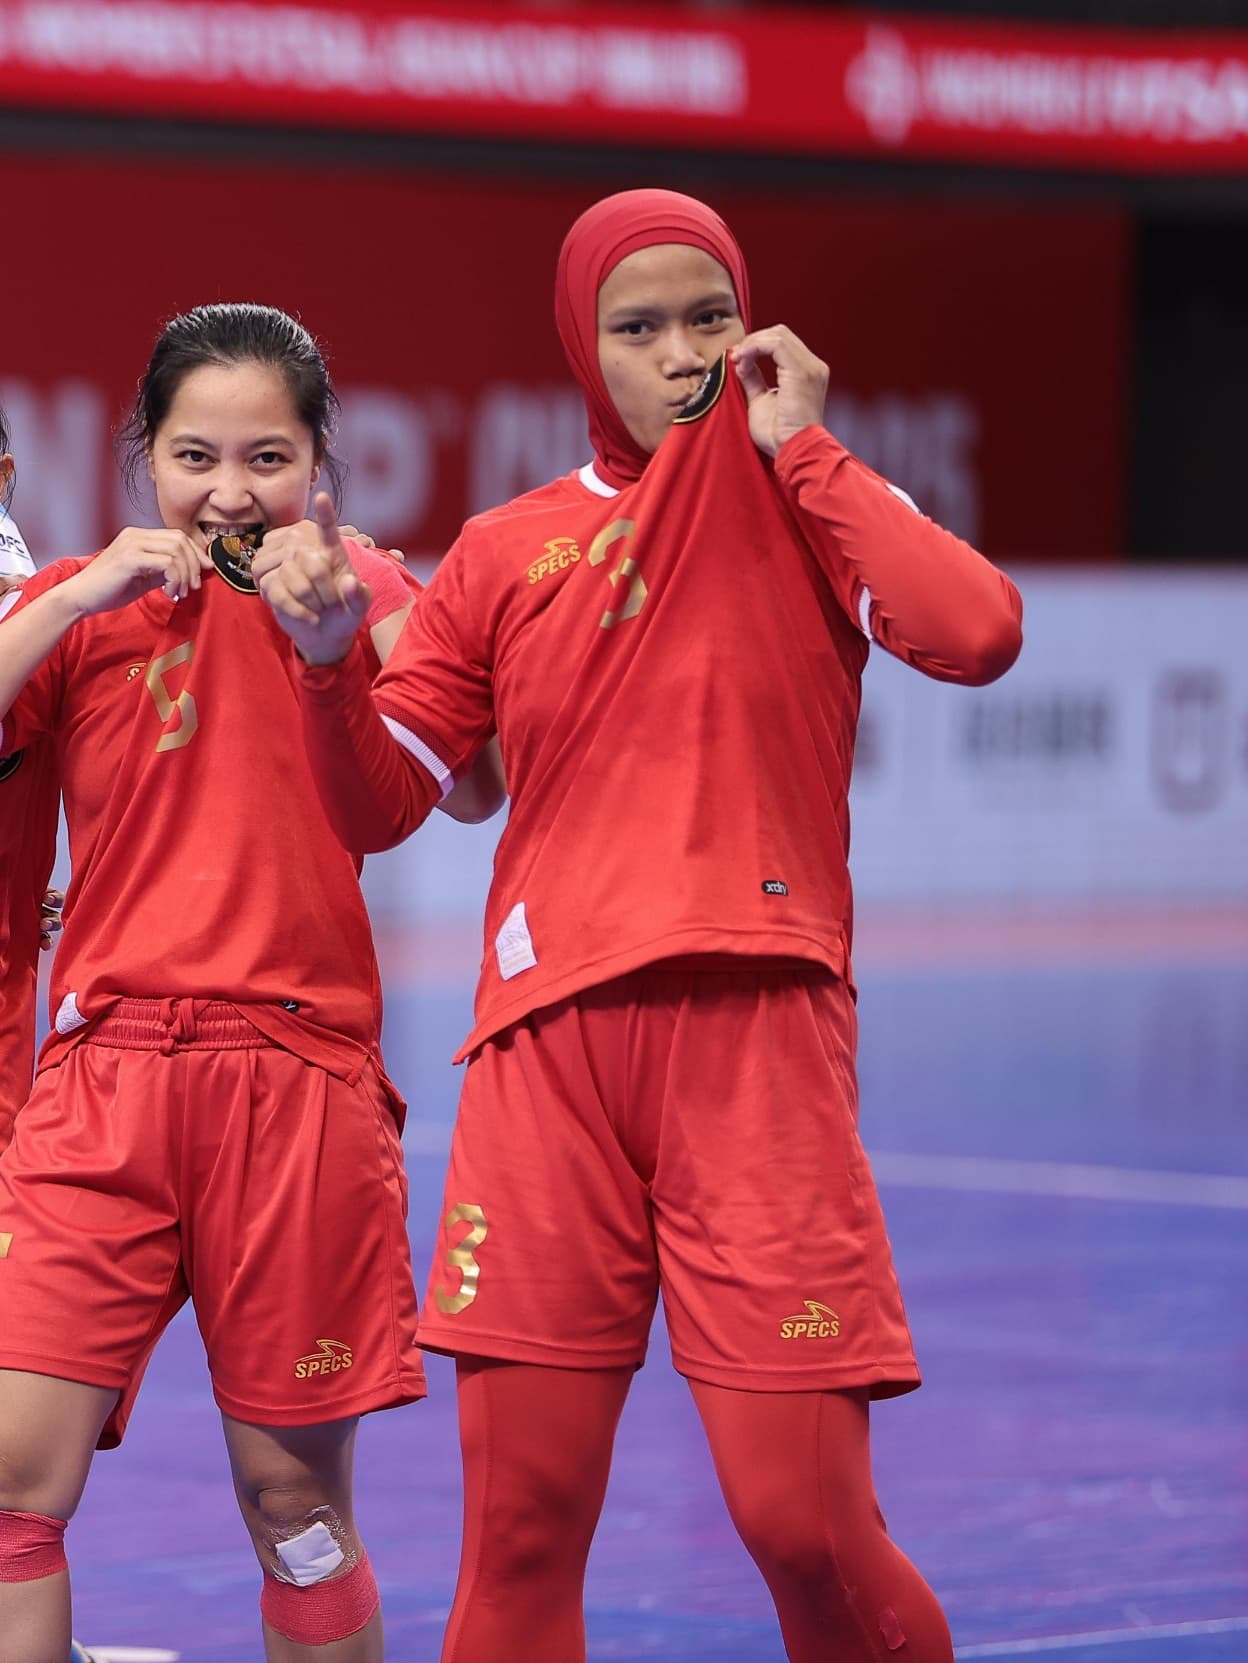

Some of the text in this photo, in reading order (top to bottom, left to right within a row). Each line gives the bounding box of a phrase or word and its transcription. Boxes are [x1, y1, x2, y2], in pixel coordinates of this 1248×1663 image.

[528, 543, 581, 585] SPECS
[588, 517, 648, 630] 3
[145, 640, 199, 753] 5
[435, 1202, 489, 1316] 3
[294, 1352, 353, 1379] SPECS
[779, 1320, 840, 1339] SPECS
